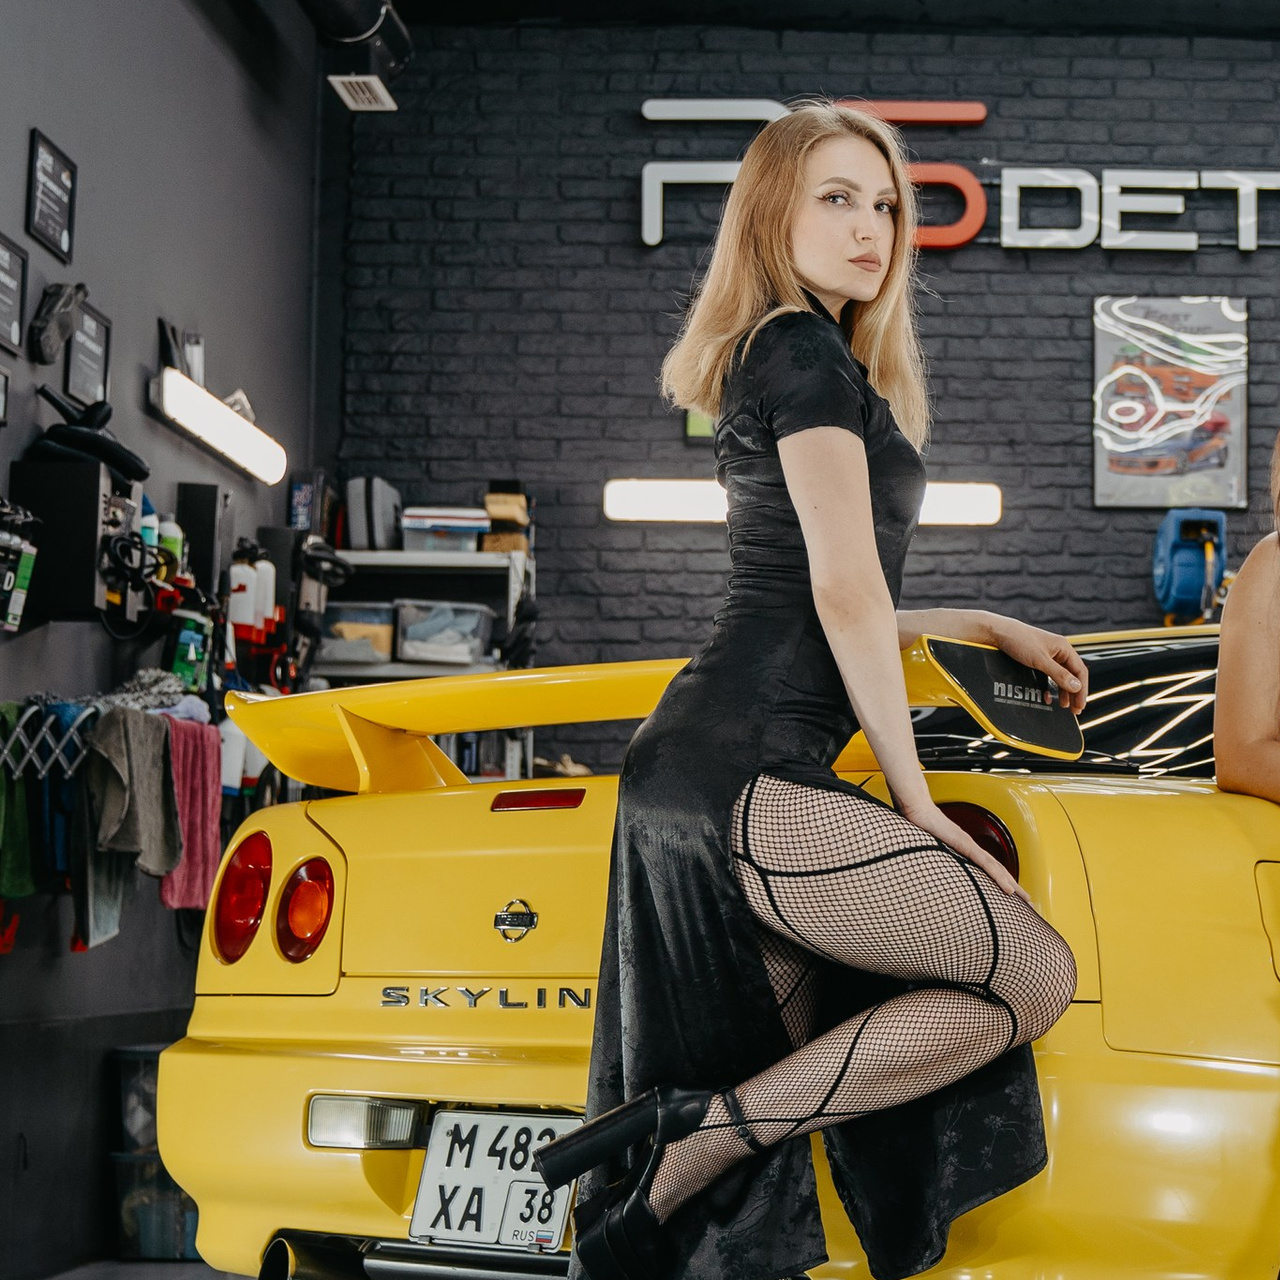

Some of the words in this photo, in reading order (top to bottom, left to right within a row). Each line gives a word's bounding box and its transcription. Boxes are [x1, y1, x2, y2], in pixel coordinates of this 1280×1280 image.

[380, 986, 591, 1008] SKYLIN
[519, 1188, 555, 1225] 38
[512, 1229, 535, 1242] RUS
